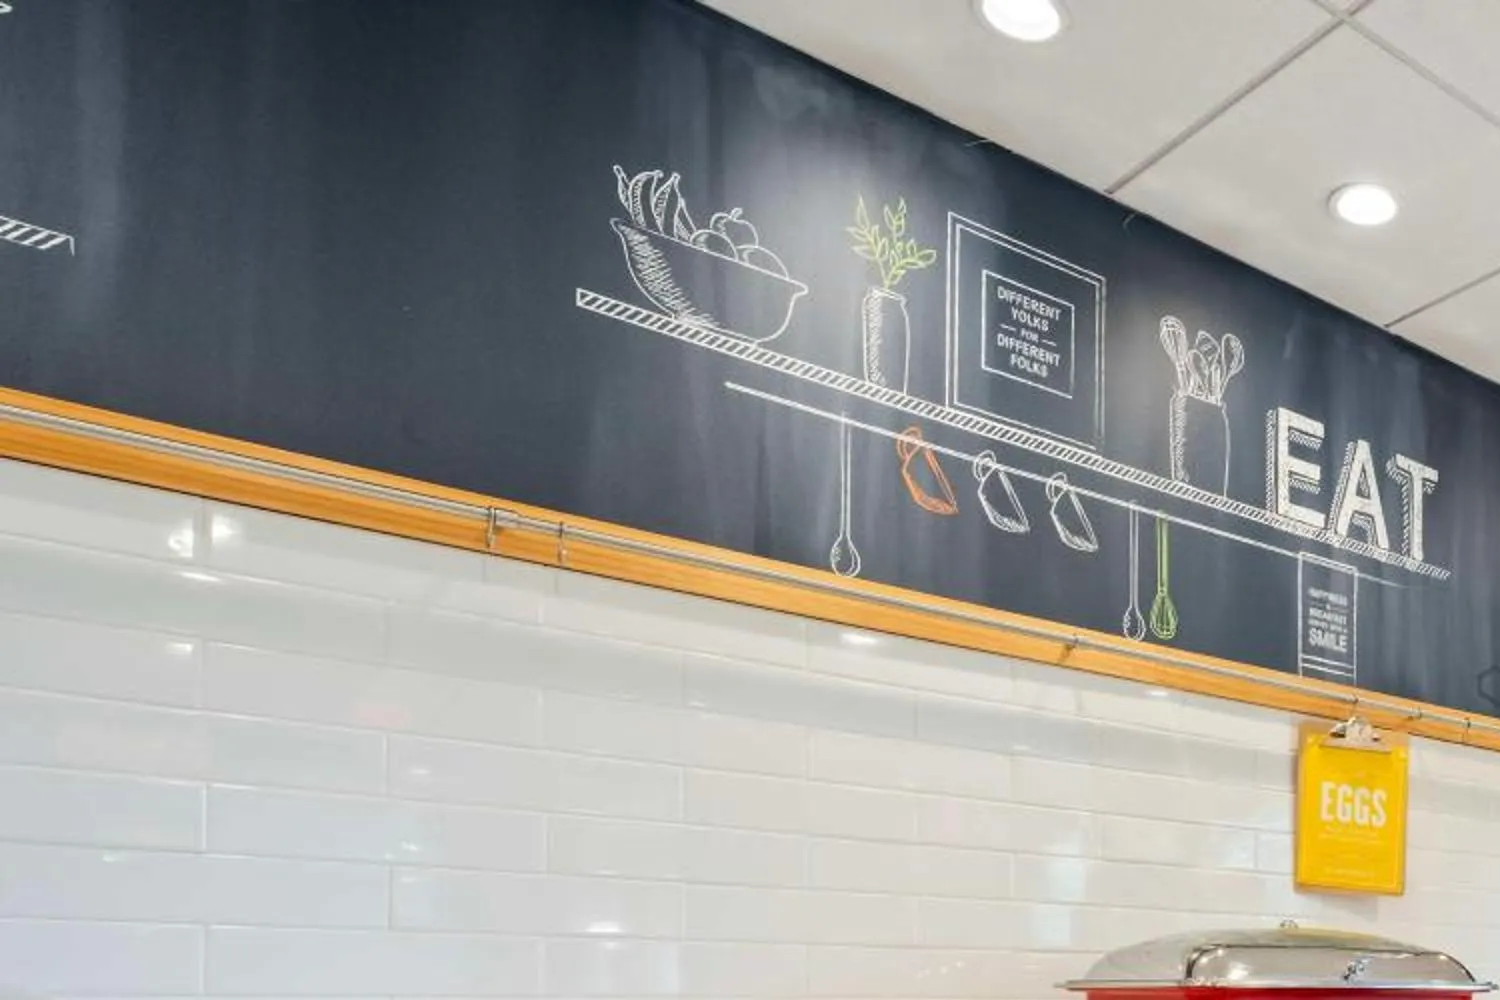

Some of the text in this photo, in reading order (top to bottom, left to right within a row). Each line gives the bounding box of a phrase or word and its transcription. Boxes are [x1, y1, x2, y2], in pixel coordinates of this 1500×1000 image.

[997, 285, 1062, 321] DIFFERENT
[1011, 307, 1049, 331] YOLKS
[997, 333, 1061, 367] DIFFERENT
[1021, 330, 1039, 343] FOR
[1010, 353, 1049, 378] FOLKS
[1266, 406, 1440, 562] EAT
[1309, 627, 1348, 653] SMILE
[1320, 780, 1387, 829] EGGS
